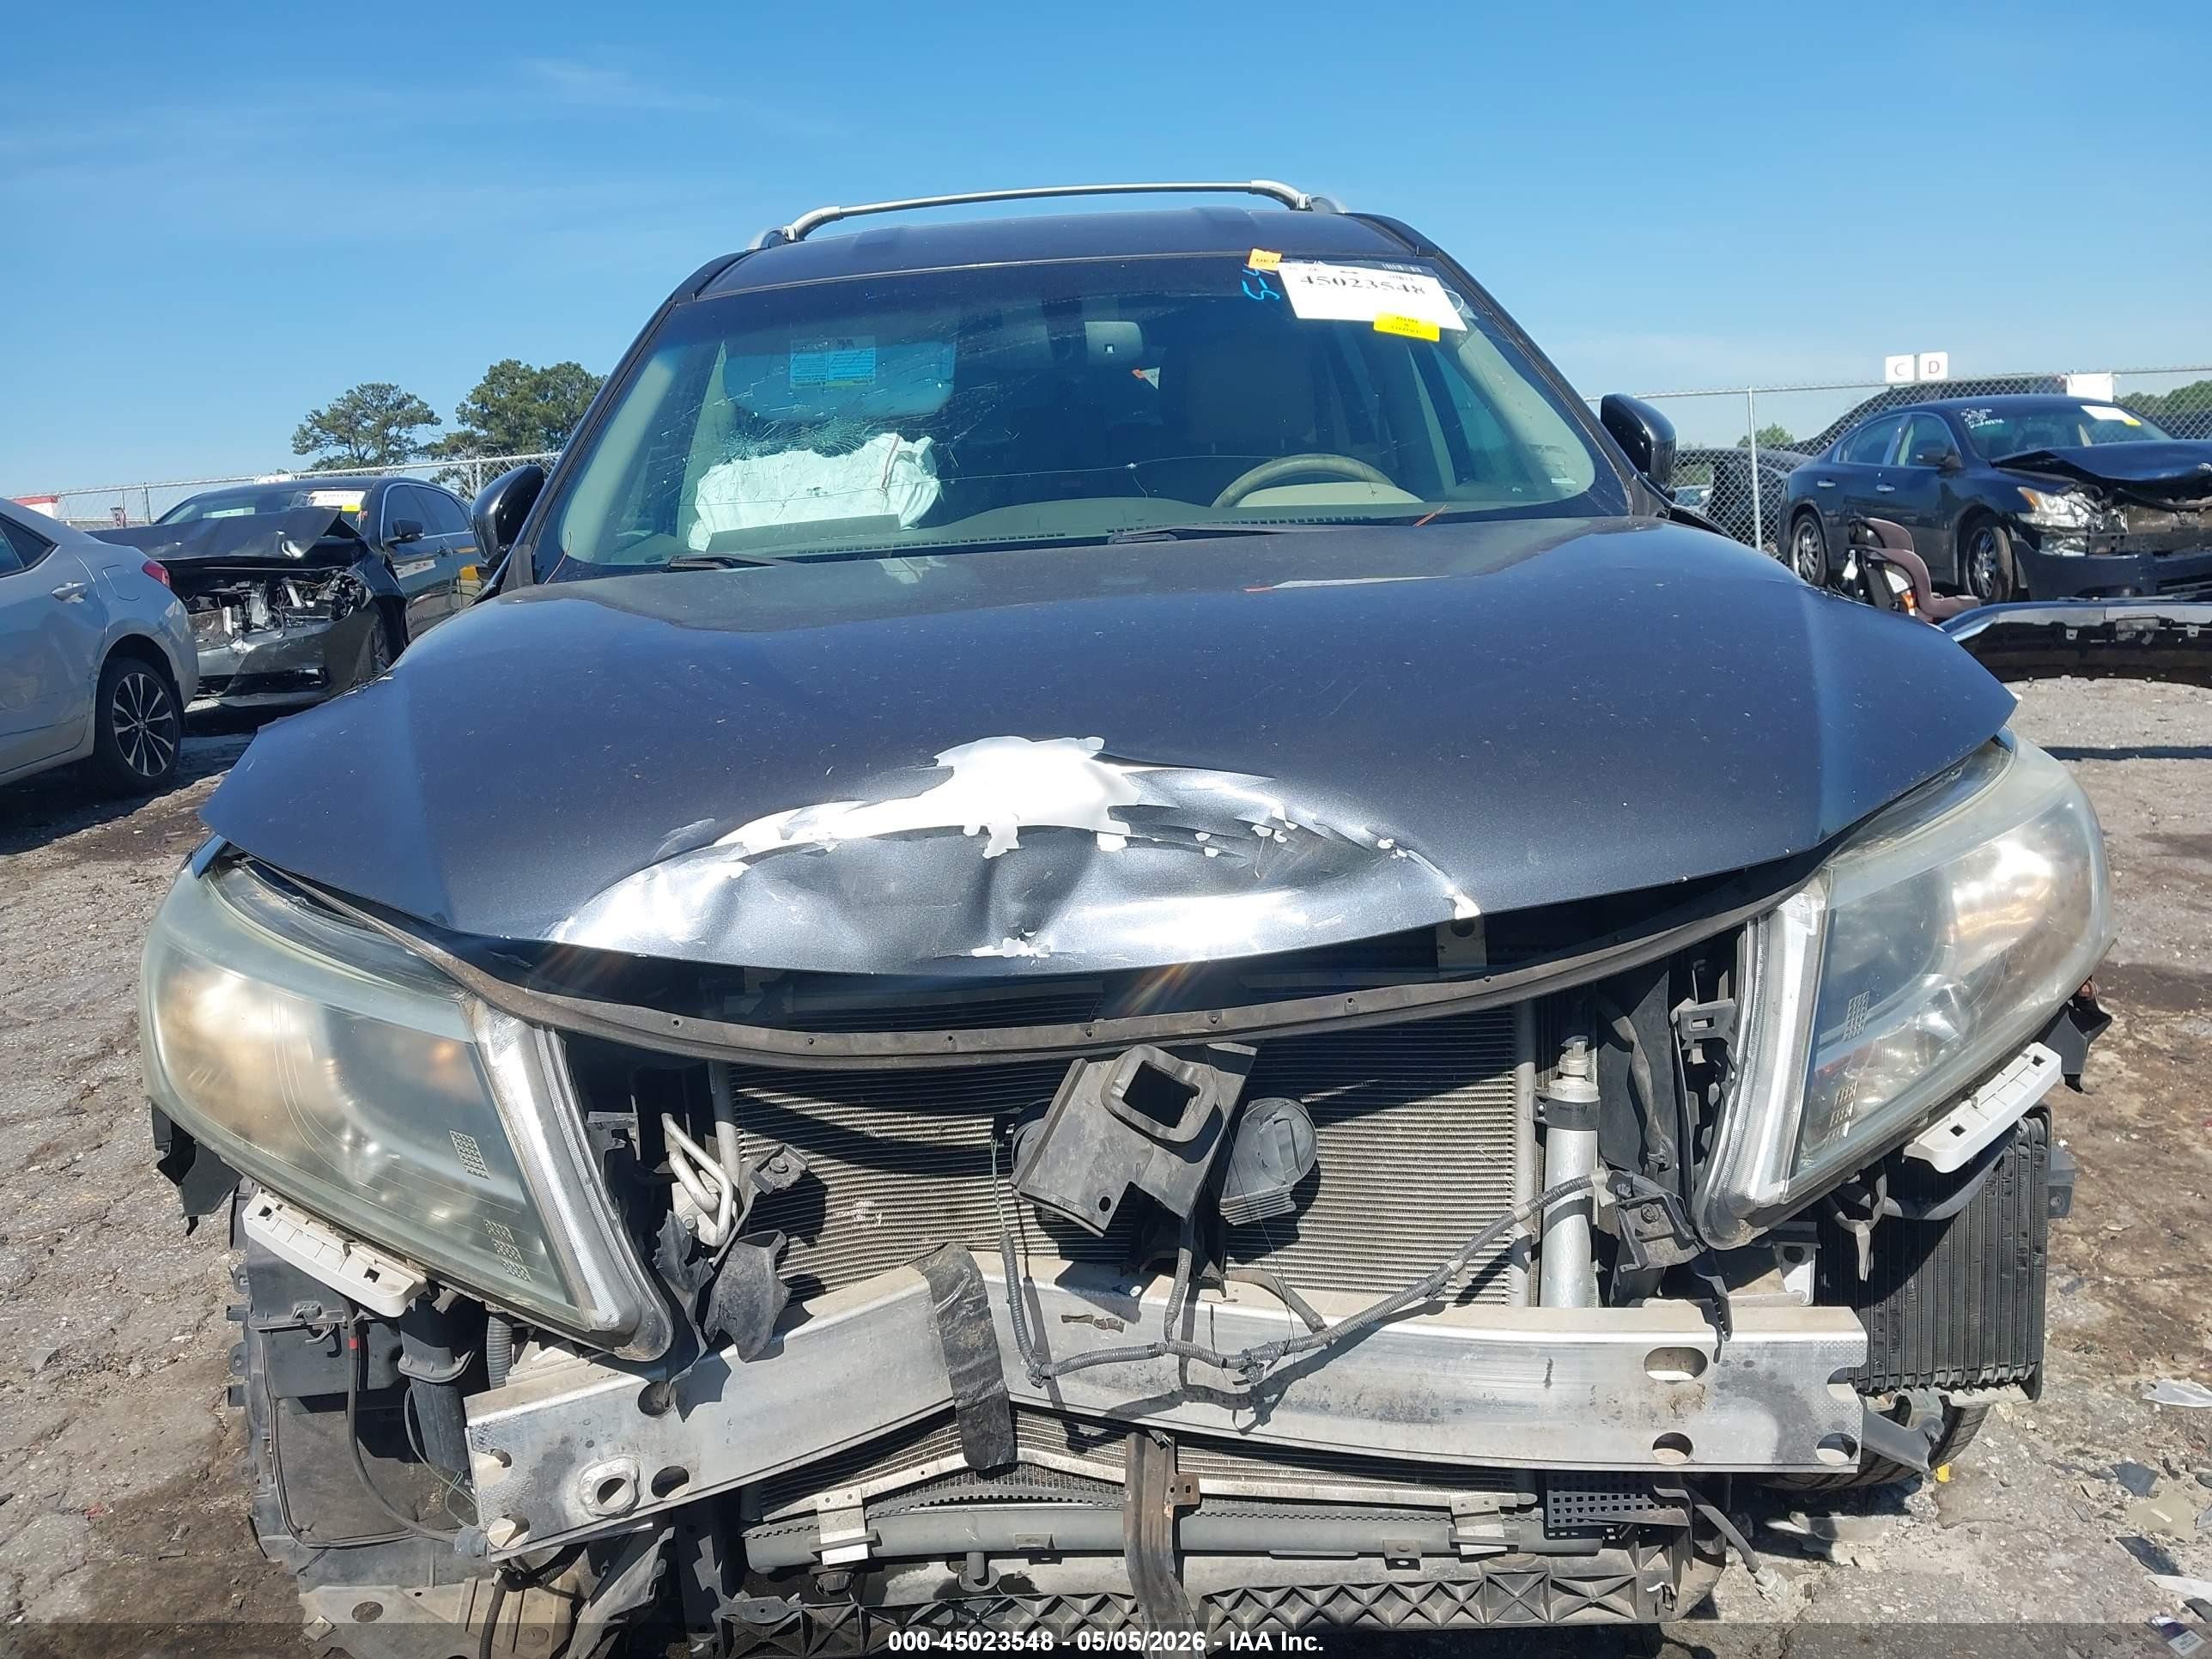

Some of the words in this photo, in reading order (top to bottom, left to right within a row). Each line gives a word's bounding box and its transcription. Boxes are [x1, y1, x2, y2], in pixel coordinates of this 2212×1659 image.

[1300, 274, 1425, 295] 45023548
[1894, 362, 1906, 377] C
[1928, 360, 1941, 374] D
